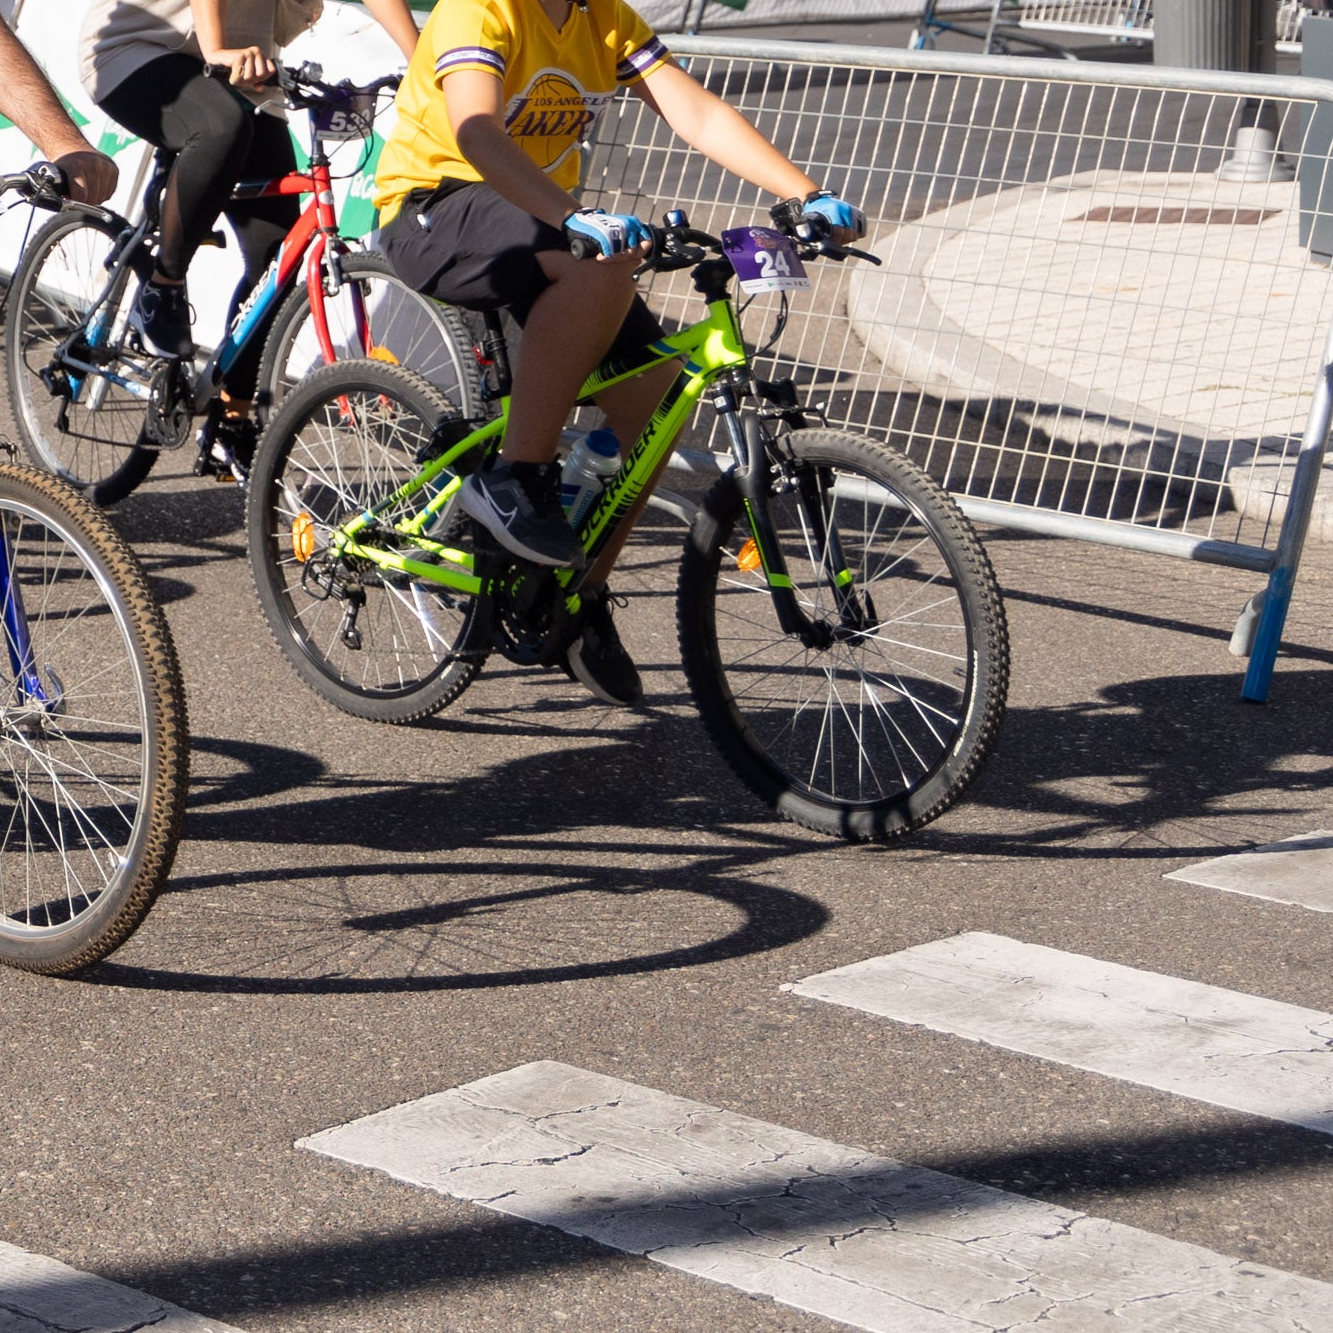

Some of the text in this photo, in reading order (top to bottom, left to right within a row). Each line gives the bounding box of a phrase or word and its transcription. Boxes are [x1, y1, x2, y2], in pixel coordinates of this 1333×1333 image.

[534, 97, 552, 107] LOS
[754, 250, 790, 278] 24
[578, 420, 656, 545] OCKRIDER
